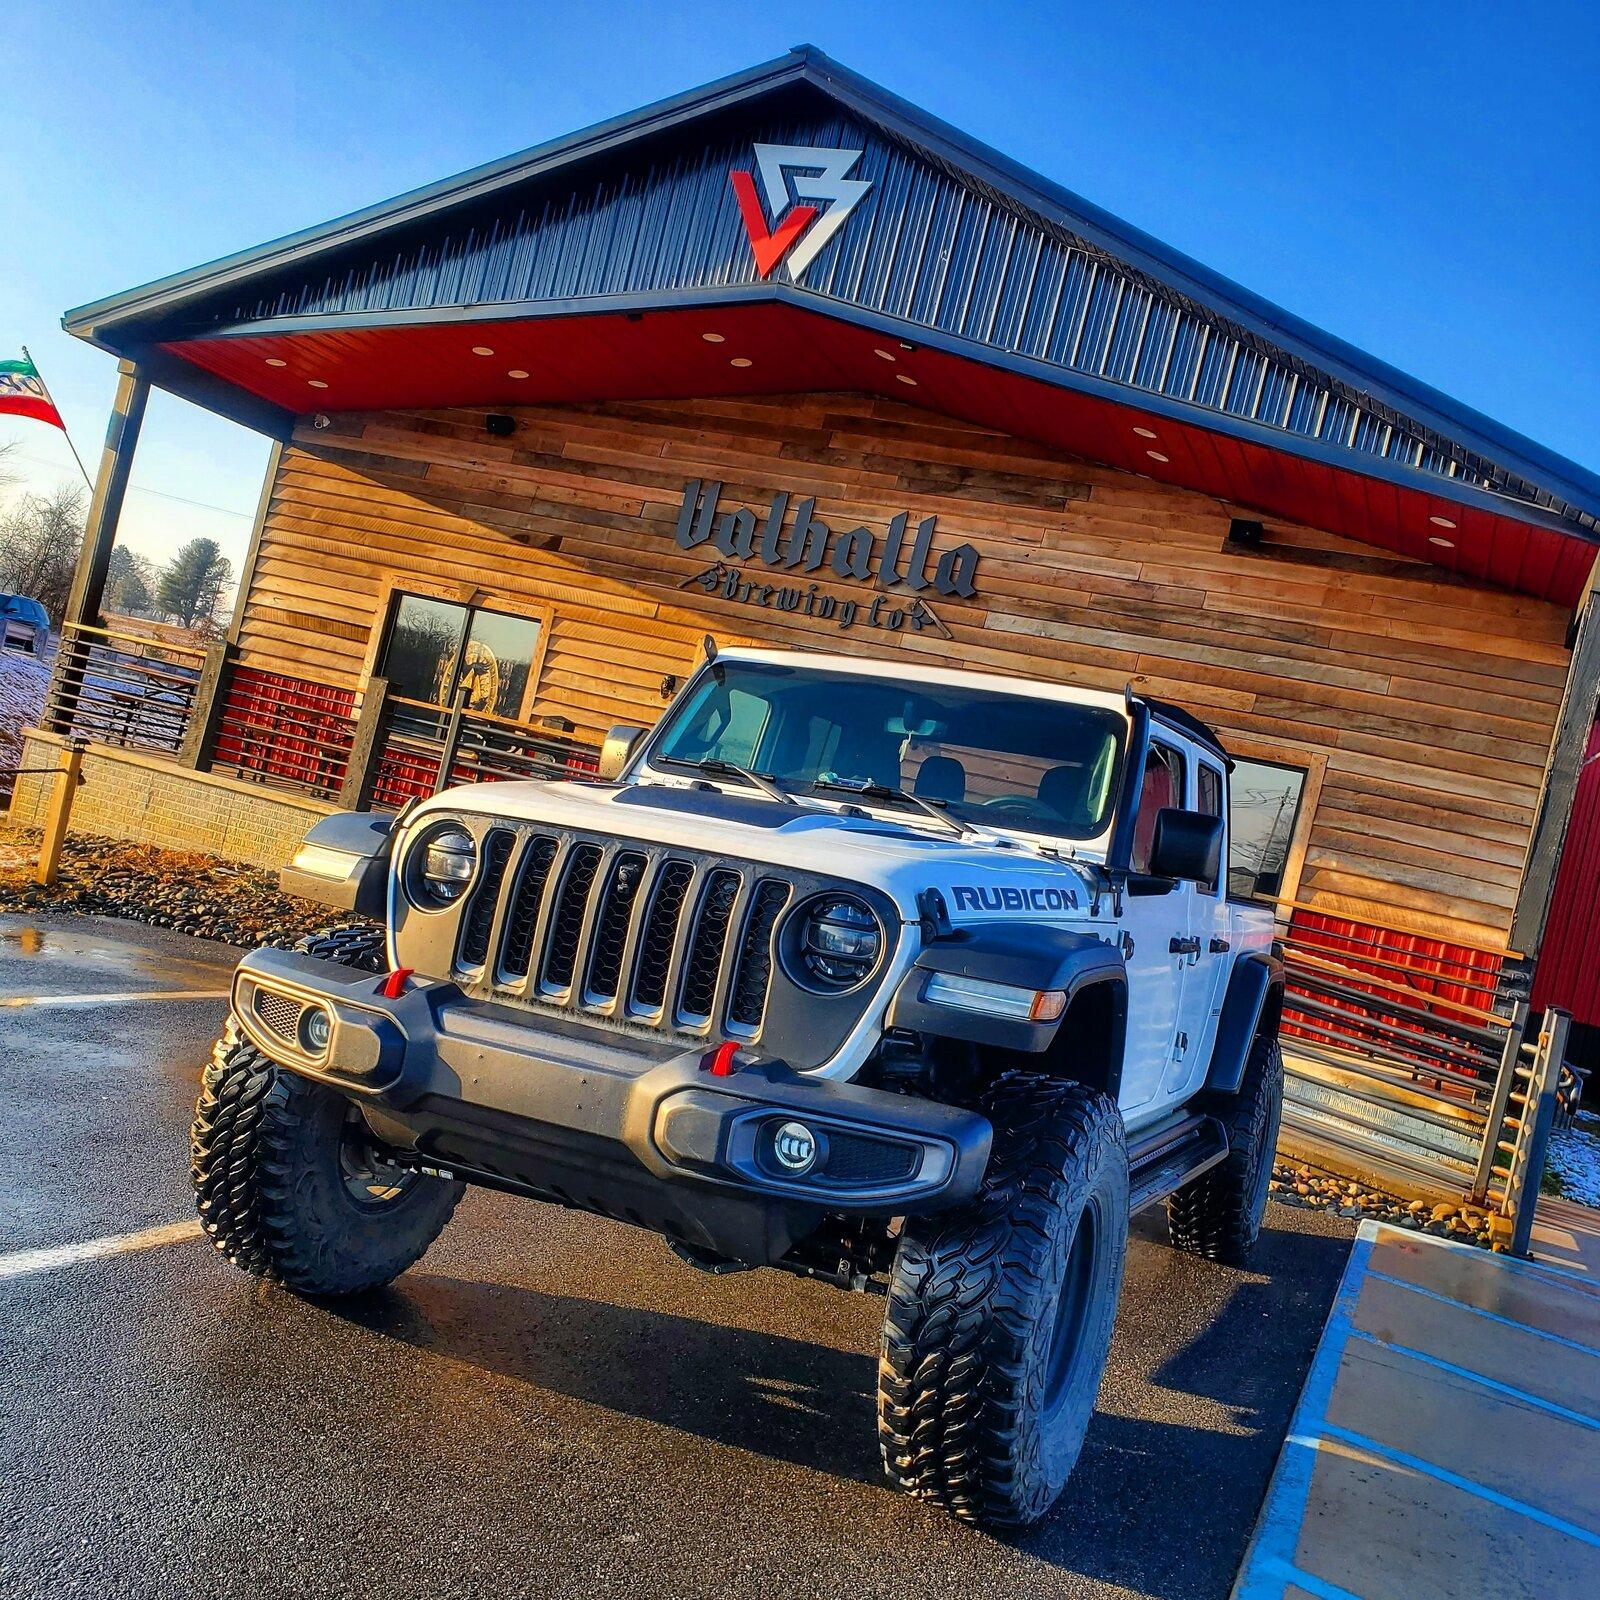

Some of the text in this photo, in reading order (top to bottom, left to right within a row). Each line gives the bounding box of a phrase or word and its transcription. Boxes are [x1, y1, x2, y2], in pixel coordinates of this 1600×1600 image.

[675, 479, 980, 598] Valhalla
[721, 568, 856, 629] Brewing
[951, 886, 1079, 911] RUBICON
